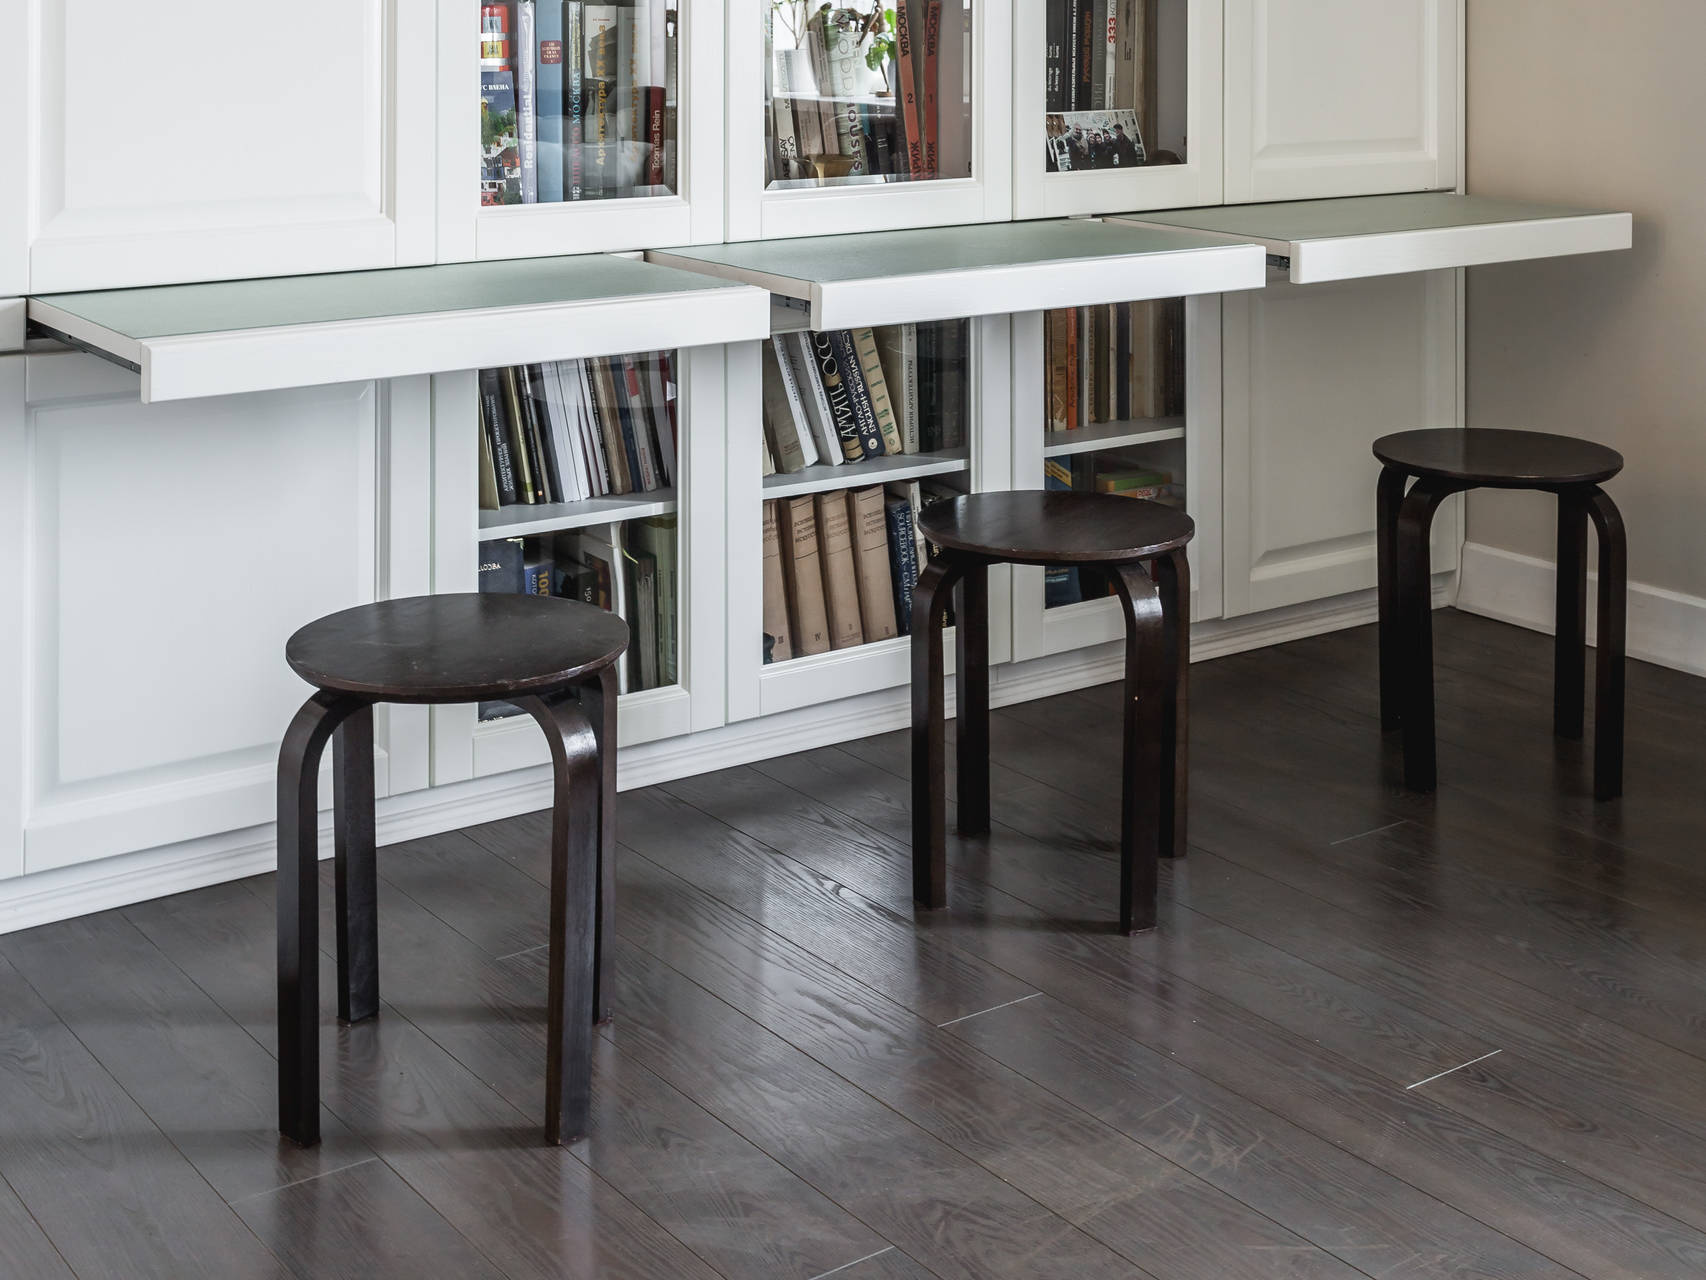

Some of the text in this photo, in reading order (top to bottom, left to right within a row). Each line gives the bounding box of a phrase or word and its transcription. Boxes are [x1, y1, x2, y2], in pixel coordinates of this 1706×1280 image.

[897, 5, 914, 104] МОСКВА 2
[927, 5, 938, 57] МОСКВА
[1108, 17, 1117, 44] 333
[571, 71, 582, 125] МОСКВА
[595, 80, 608, 166] Архитектура
[651, 109, 661, 170] Toomas Rein
[779, 137, 790, 159] SAY
[584, 586, 592, 603] 150
